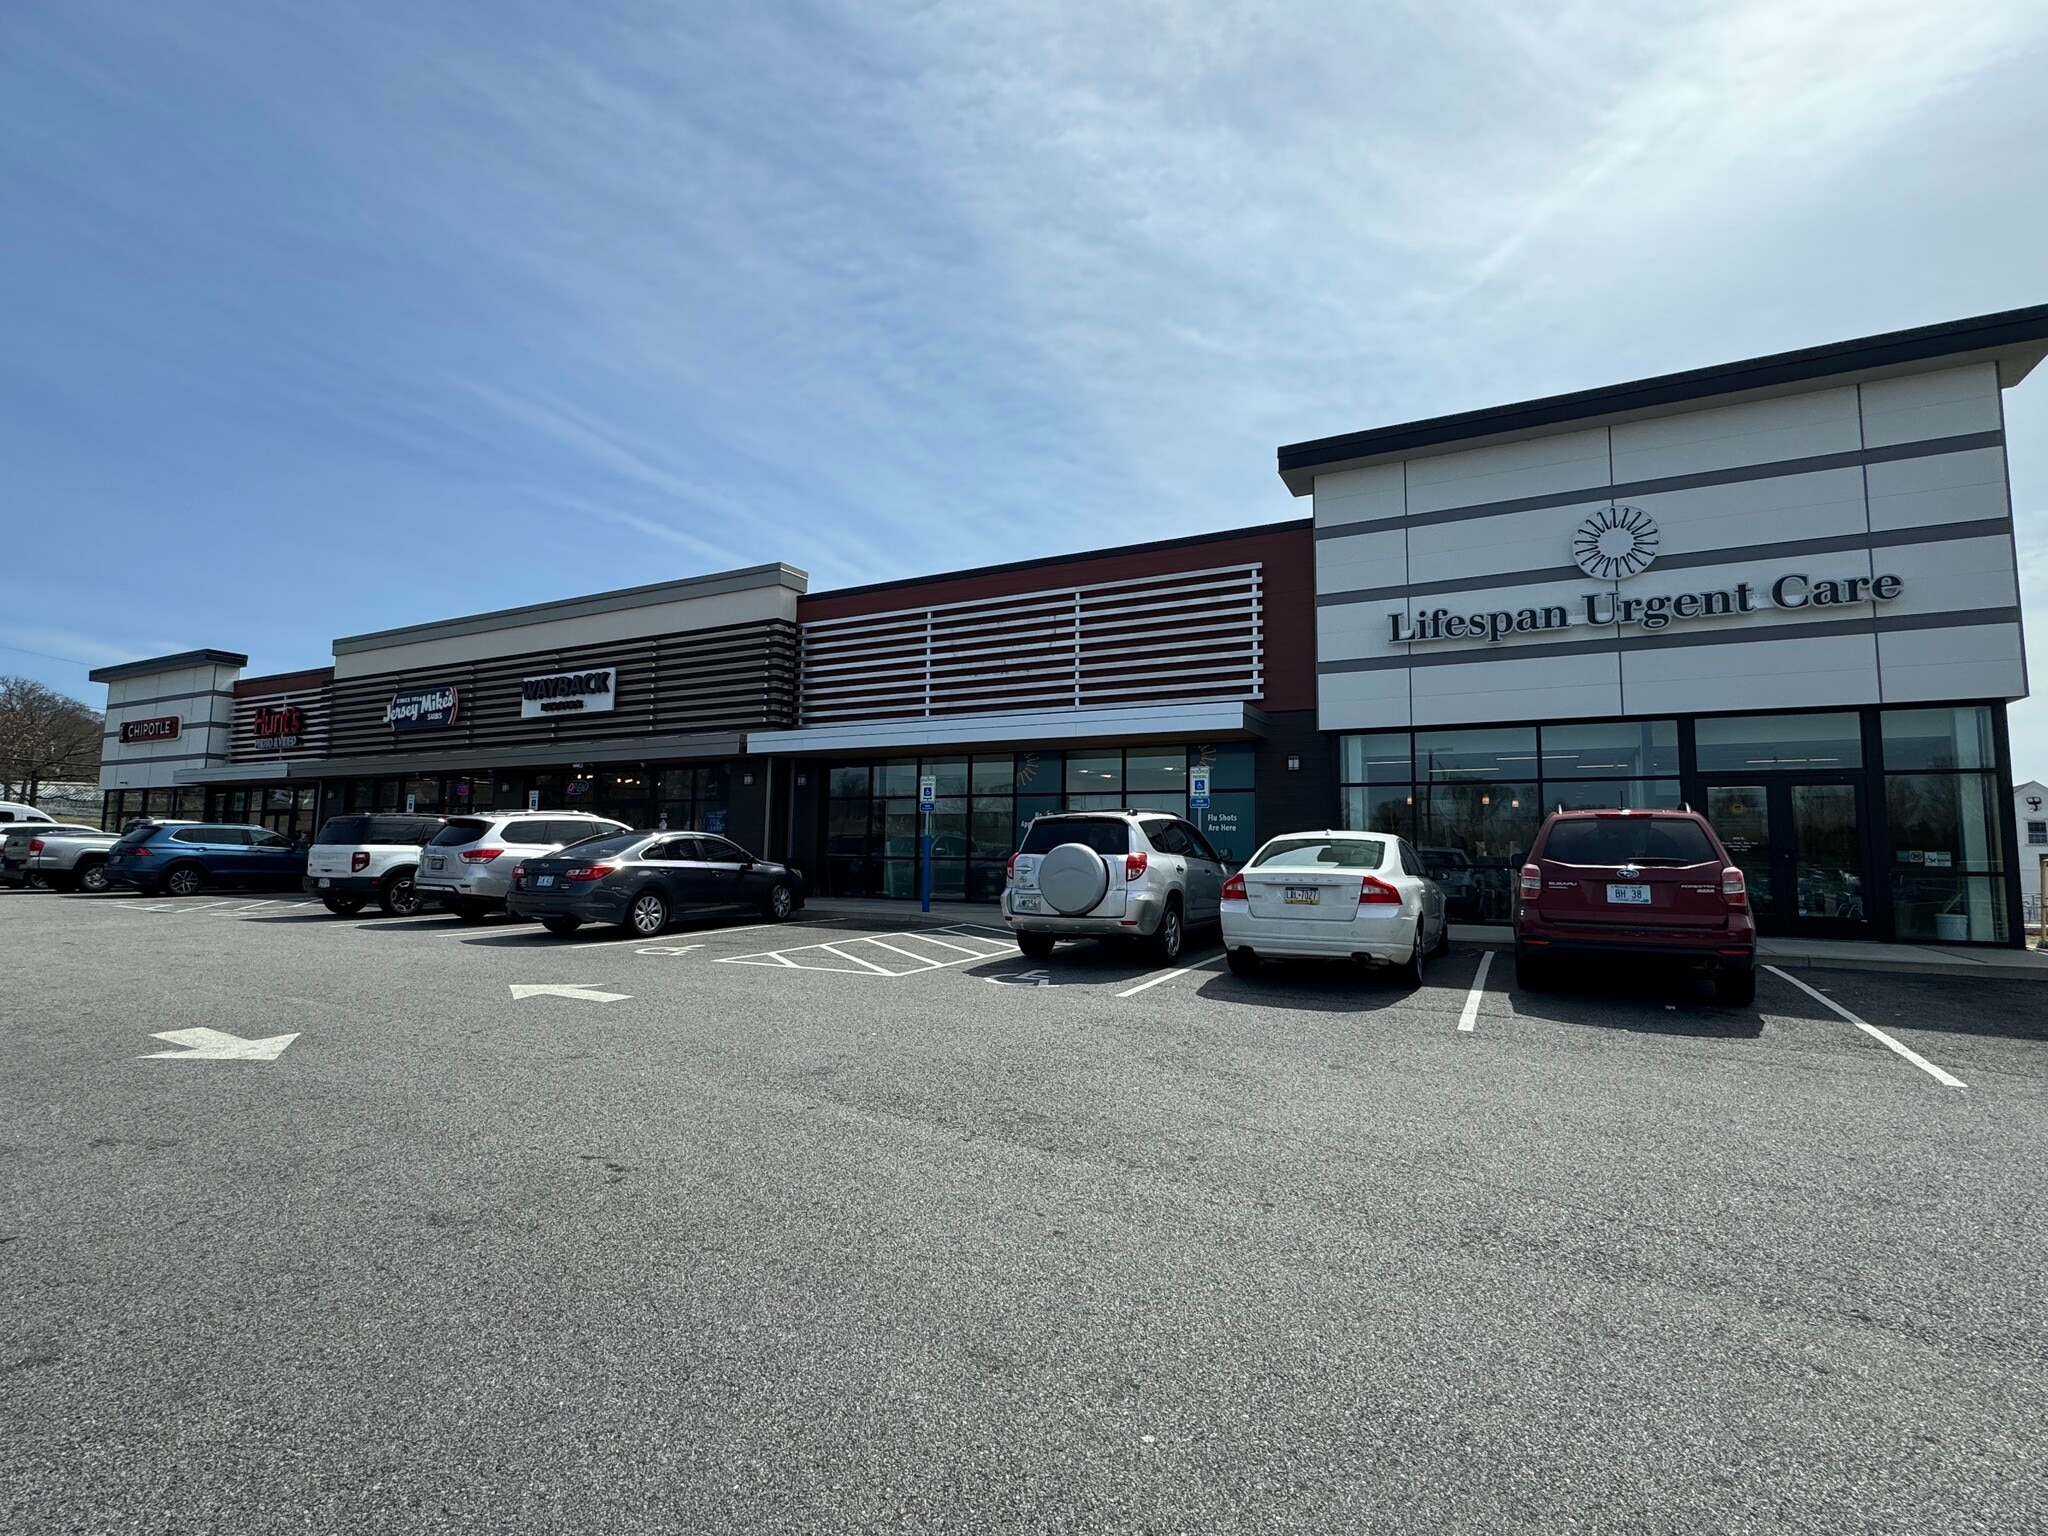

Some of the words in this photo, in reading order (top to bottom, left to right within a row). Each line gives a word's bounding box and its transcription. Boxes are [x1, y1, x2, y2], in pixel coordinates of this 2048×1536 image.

[1388, 604, 1569, 643] Lifespan
[1582, 582, 1755, 630] Urgent
[1770, 572, 1904, 609] Care
[522, 671, 611, 700] WAYBACK
[254, 706, 300, 735] Hunt's
[382, 703, 419, 723] Jersey
[420, 690, 454, 714] Mike's
[427, 712, 443, 720] SUBS
[128, 720, 171, 737] CHIPOTLE
[1615, 889, 1626, 898] BH
[1631, 889, 1642, 899] 38
